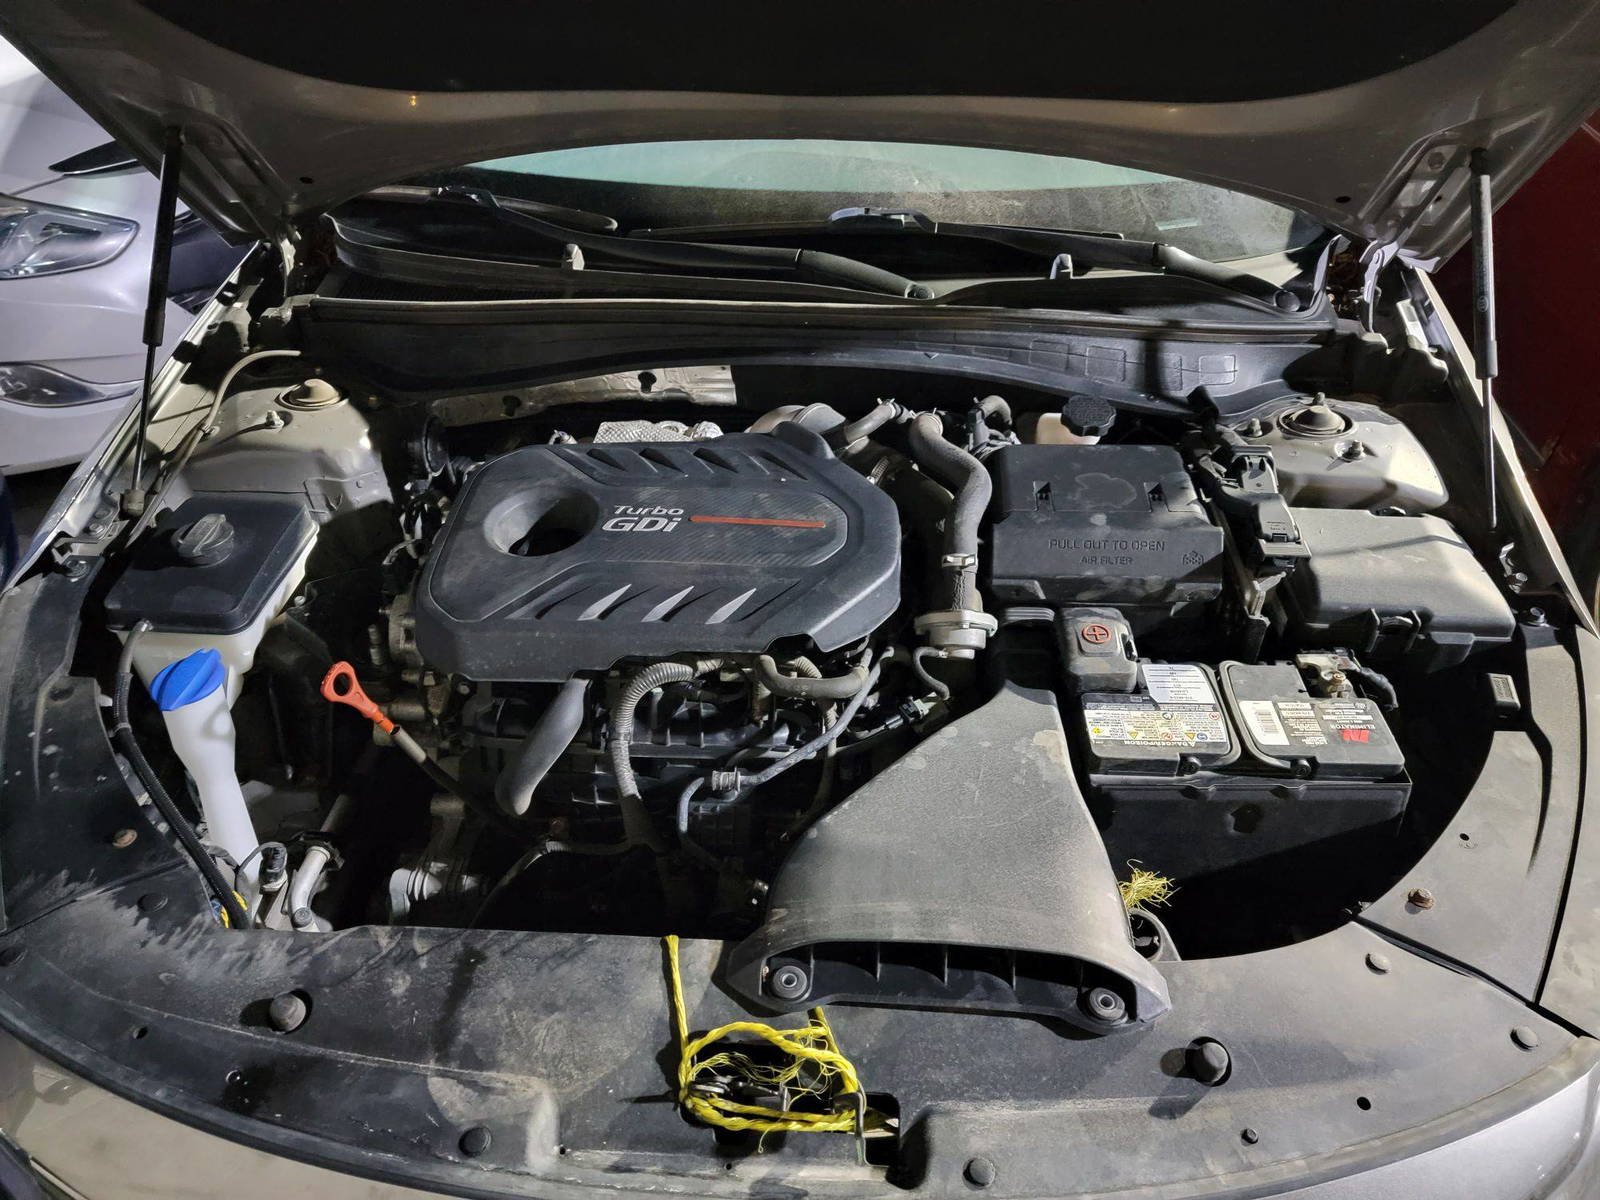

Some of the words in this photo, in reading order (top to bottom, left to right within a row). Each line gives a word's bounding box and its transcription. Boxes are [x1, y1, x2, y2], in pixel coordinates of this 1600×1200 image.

[613, 505, 685, 516] Turbo
[602, 517, 682, 532] GDi
[1049, 538, 1081, 550] PULL
[1083, 539, 1109, 550] OUT
[1112, 540, 1128, 551] TO
[1131, 540, 1166, 552] OPEN
[1081, 555, 1098, 564] AIR
[1100, 555, 1133, 565] FILTER
